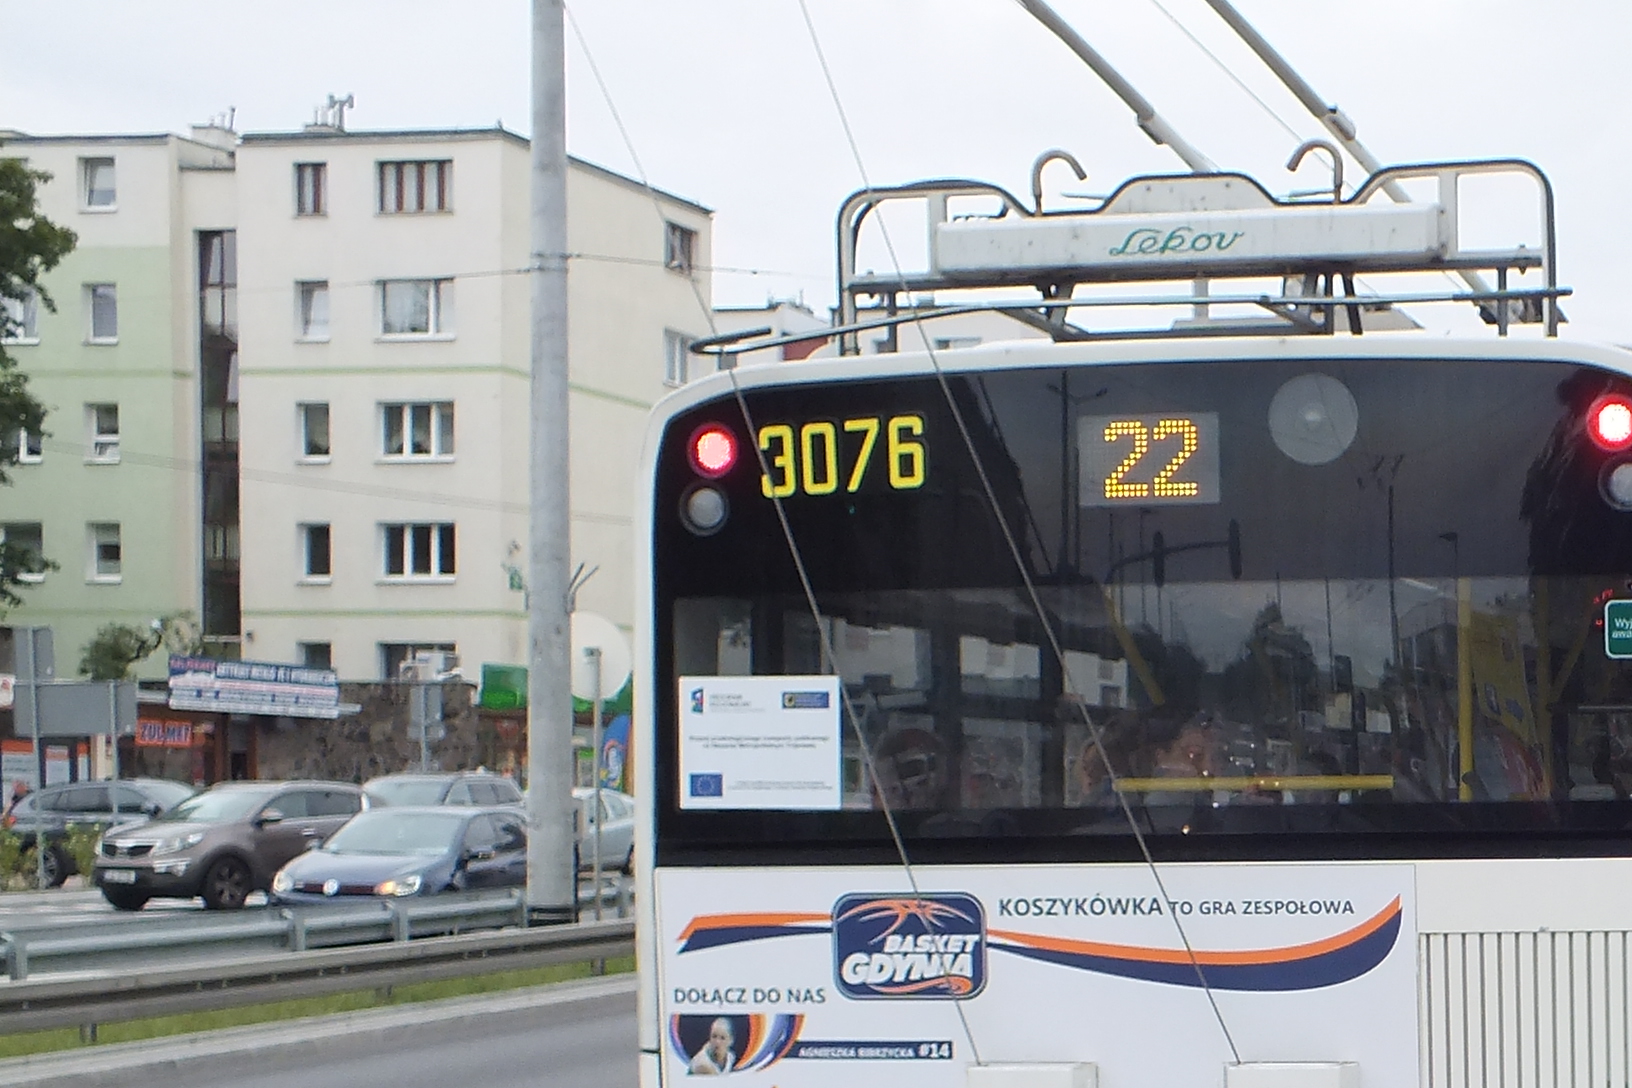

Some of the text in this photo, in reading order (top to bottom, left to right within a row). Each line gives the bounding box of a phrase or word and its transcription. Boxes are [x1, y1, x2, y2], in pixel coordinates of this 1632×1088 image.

[1108, 225, 1245, 255] Lekov
[758, 413, 926, 499] 3076
[1104, 419, 1198, 498] 22
[999, 892, 1355, 917] KOSZYKÓWKA TO GRA ZESPOŁOWA
[883, 934, 981, 954] BASKET
[841, 953, 973, 985] GDYNIA
[674, 986, 827, 1008] DOŁĄCZ DO NAS
[918, 1043, 951, 1059] #14
